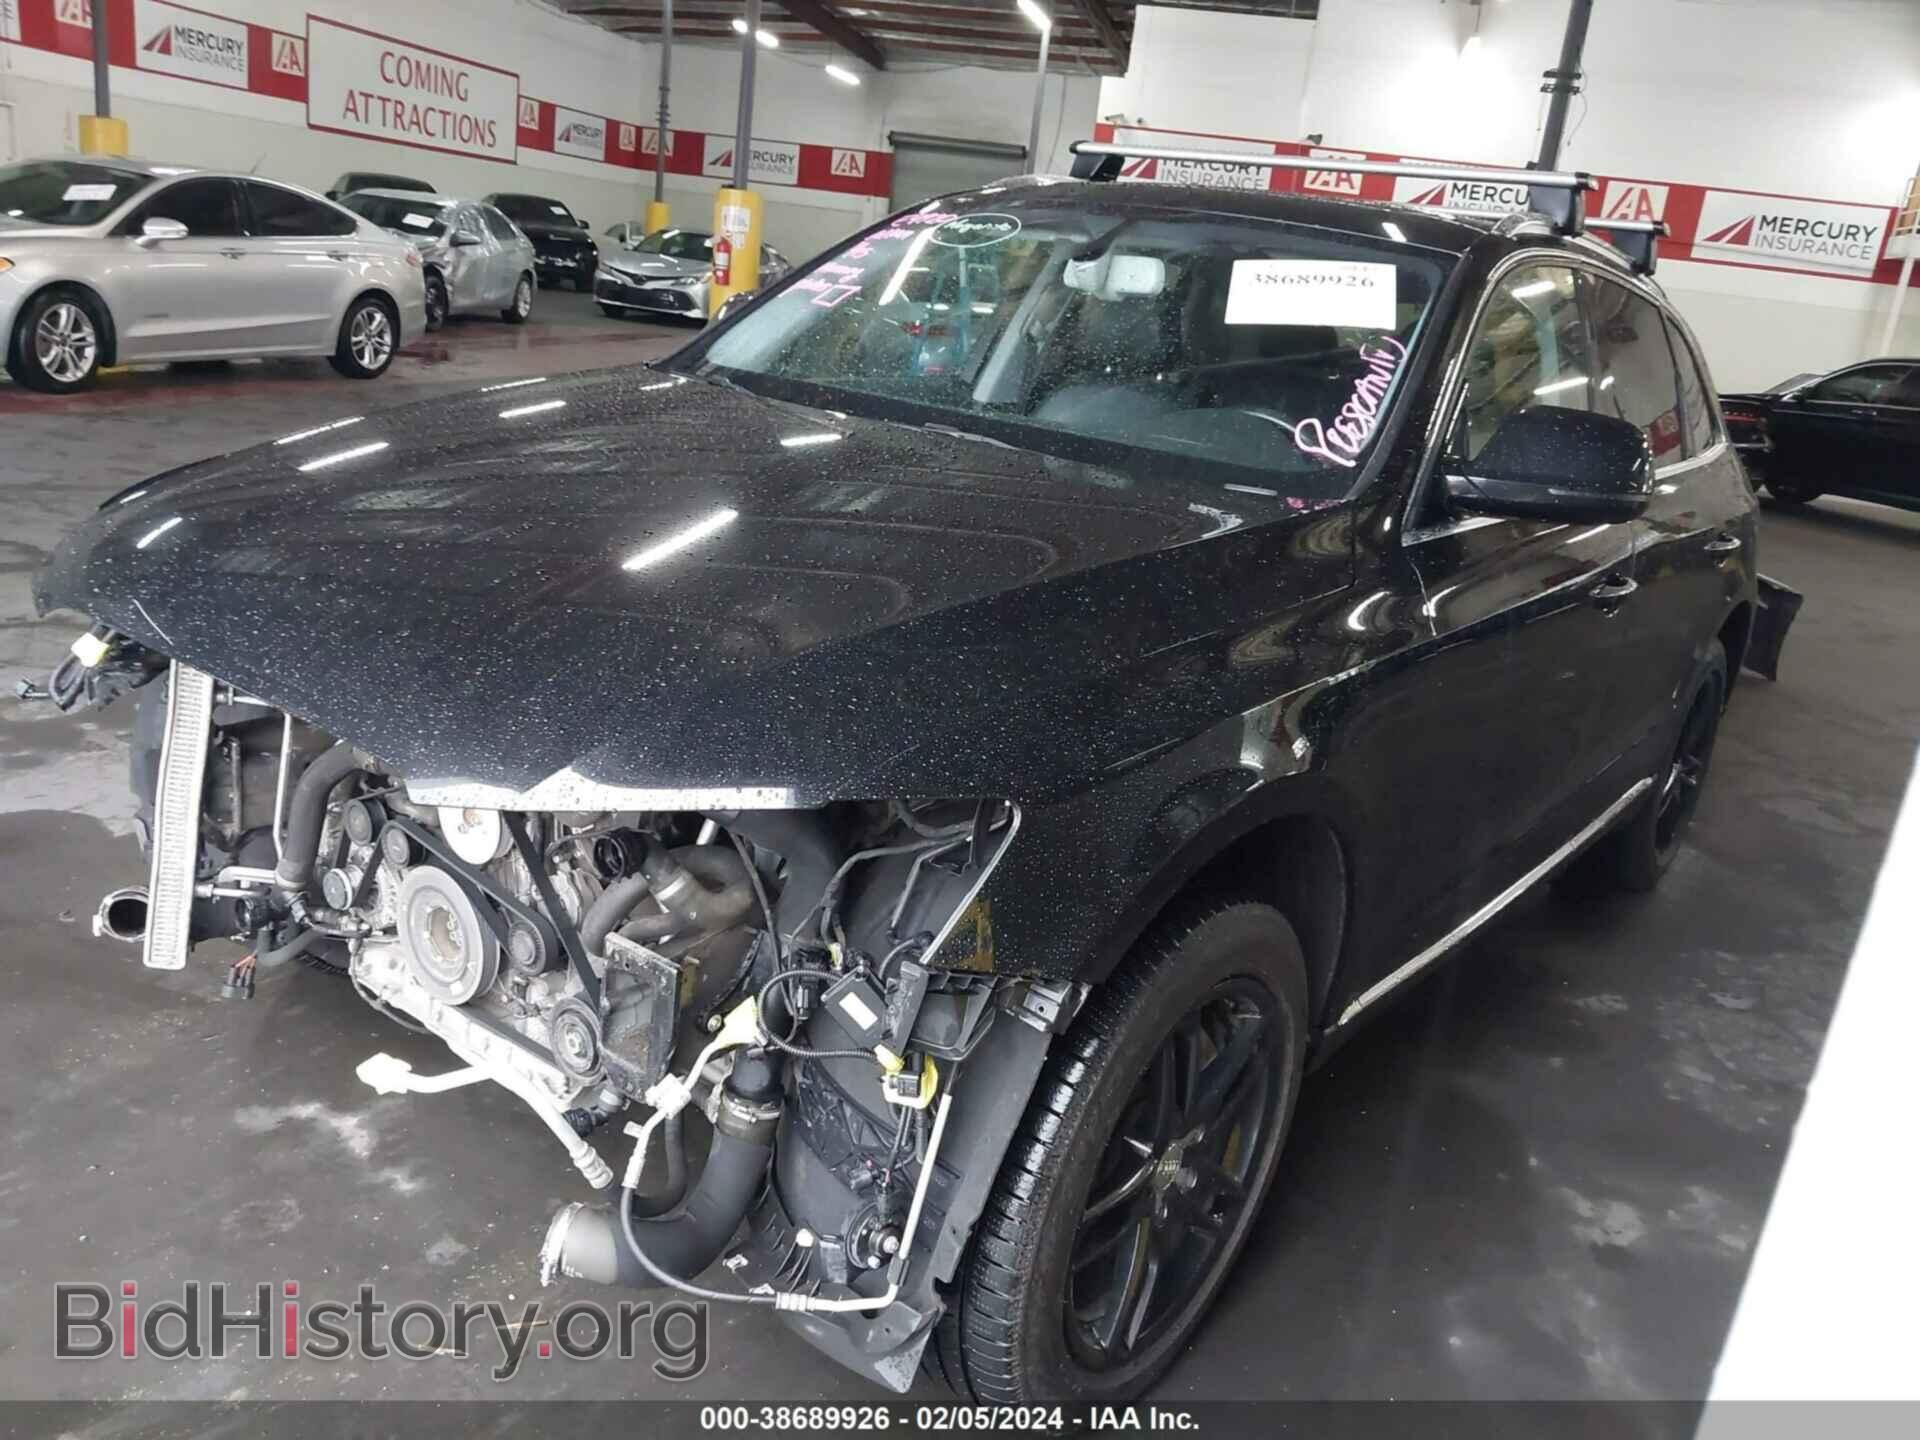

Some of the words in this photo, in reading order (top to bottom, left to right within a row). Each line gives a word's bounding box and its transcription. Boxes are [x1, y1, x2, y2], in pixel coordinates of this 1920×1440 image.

[174, 25, 243, 56] MERCURY
[175, 46, 244, 72] INSURANCE
[380, 51, 469, 102] COMING
[343, 89, 497, 148] ATTRACTIONS
[752, 150, 795, 166] RCURY
[1160, 168, 1264, 190] INSURANCE
[1450, 182, 1530, 206] MERCU
[1758, 214, 1878, 243] MERCURY
[1754, 233, 1873, 261] INSURANCE
